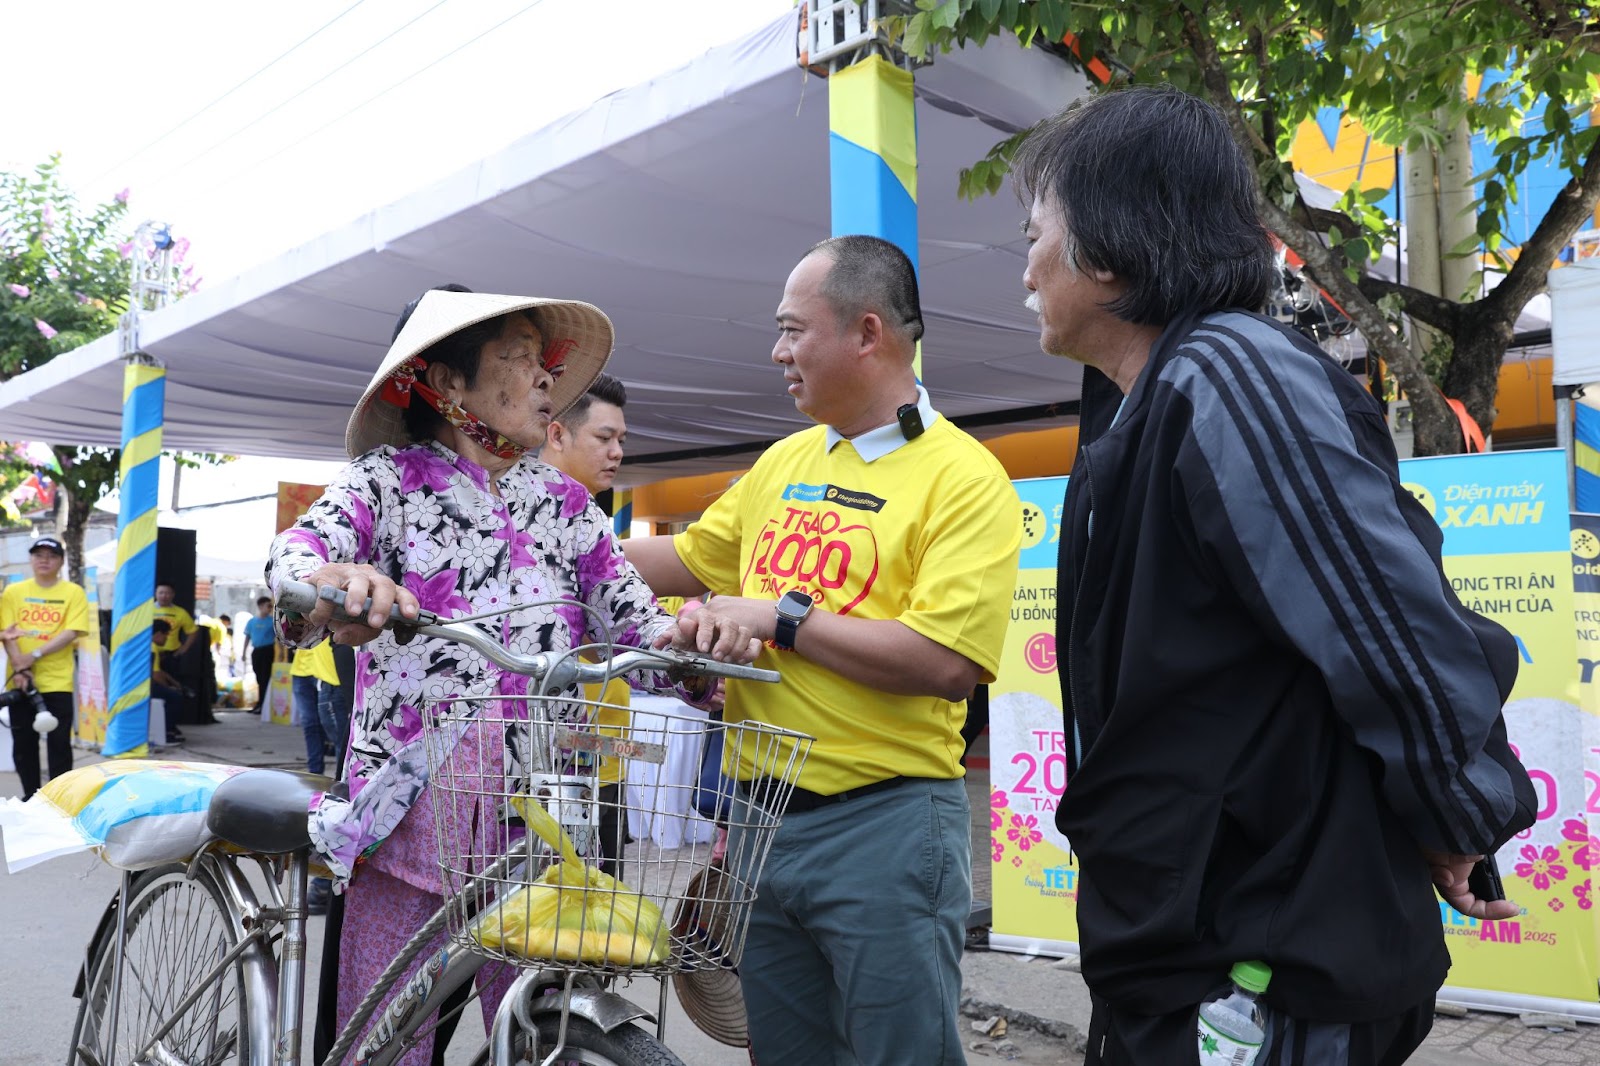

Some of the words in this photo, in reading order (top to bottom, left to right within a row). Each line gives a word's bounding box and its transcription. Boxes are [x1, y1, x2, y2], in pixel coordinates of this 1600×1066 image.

[1443, 483, 1492, 504] Điện
[1494, 480, 1544, 500] máy
[1440, 501, 1545, 528] XANH
[1014, 586, 1037, 600] ÂN
[1451, 577, 1489, 594] ỌNG
[1493, 576, 1522, 590] TRI
[1527, 572, 1555, 589] ÂN
[1516, 594, 1554, 613] CỦA
[1010, 607, 1020, 622] Ự
[1576, 629, 1599, 641] NG
[1032, 731, 1067, 752] TR
[1011, 752, 1067, 796] 2.0
[1042, 864, 1076, 890] TẾT
[1523, 931, 1557, 945] 2025
